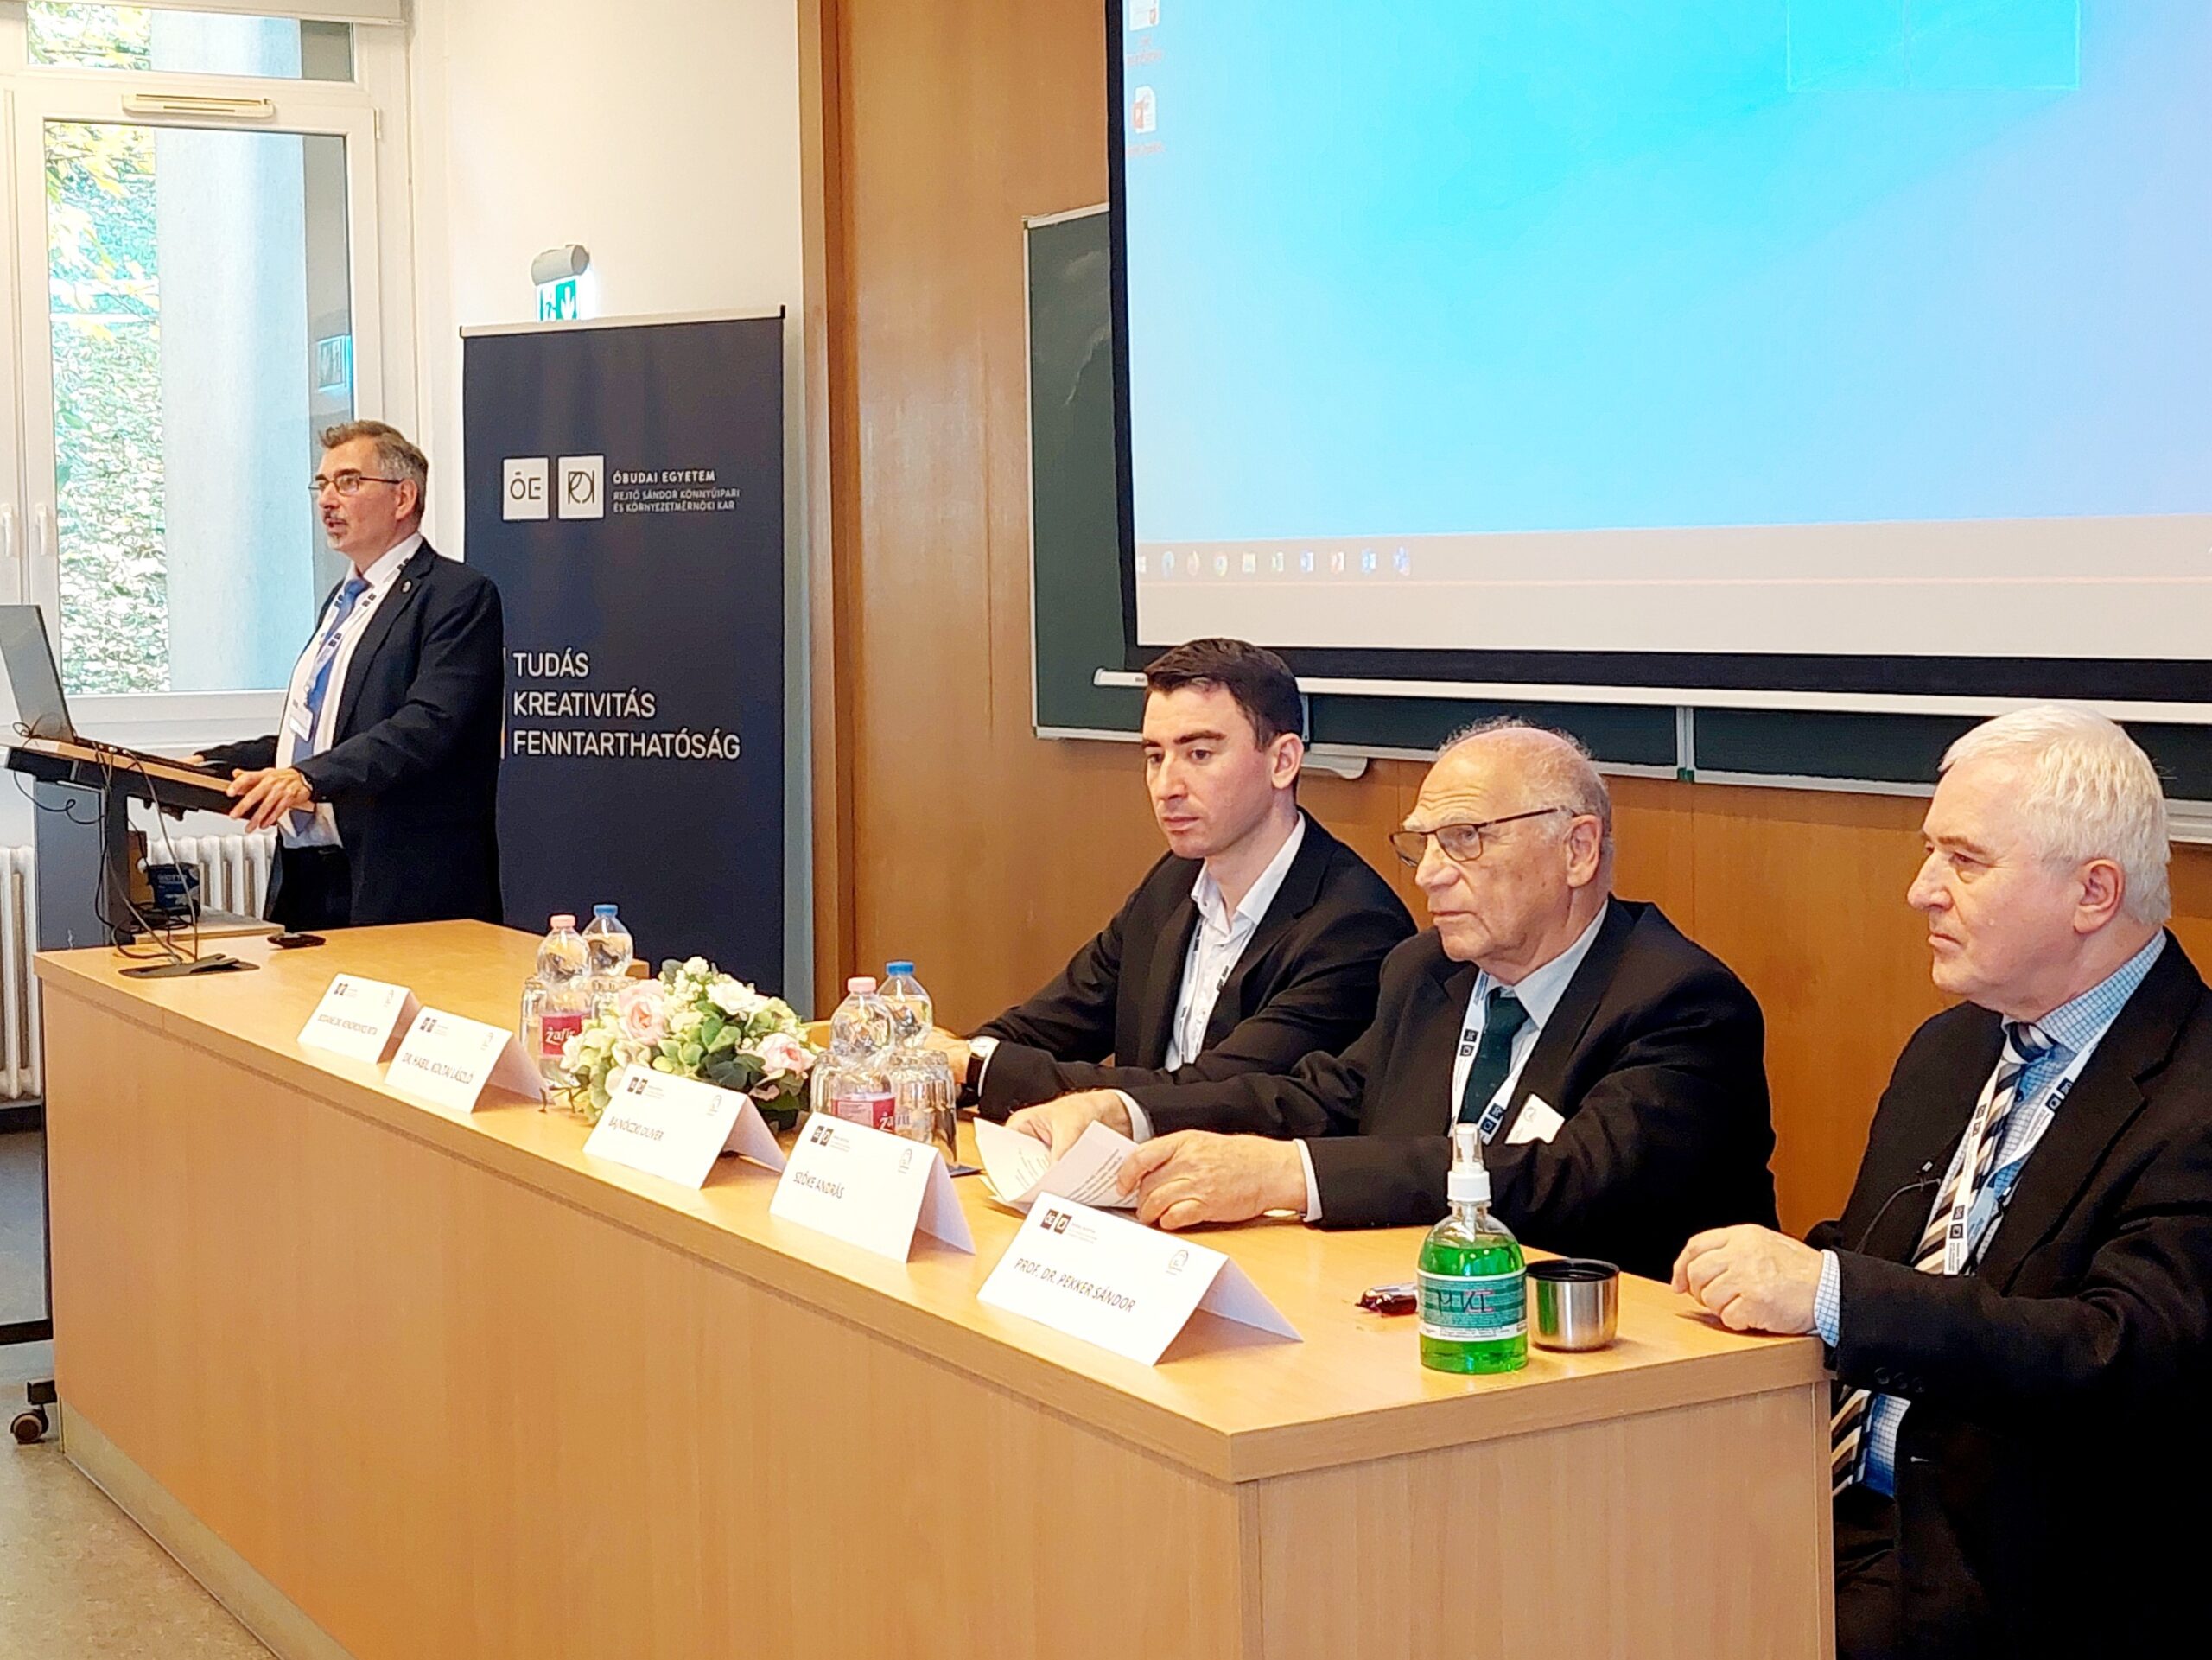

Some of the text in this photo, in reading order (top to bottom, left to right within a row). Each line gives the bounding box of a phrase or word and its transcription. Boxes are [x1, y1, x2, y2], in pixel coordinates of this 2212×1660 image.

[613, 469, 715, 484] ÓBUDAI EGYETEM
[613, 499, 624, 512] ÉS
[716, 498, 736, 510] KAR
[642, 487, 678, 501] SÁNDOR
[512, 647, 589, 677] TUDÁS
[513, 687, 657, 718] KREATIVITÁS
[512, 728, 741, 760] FENNTARTHATÓSÁG
[1014, 1257, 1136, 1313] PROF. DR. PEKKER SÁNDOR
